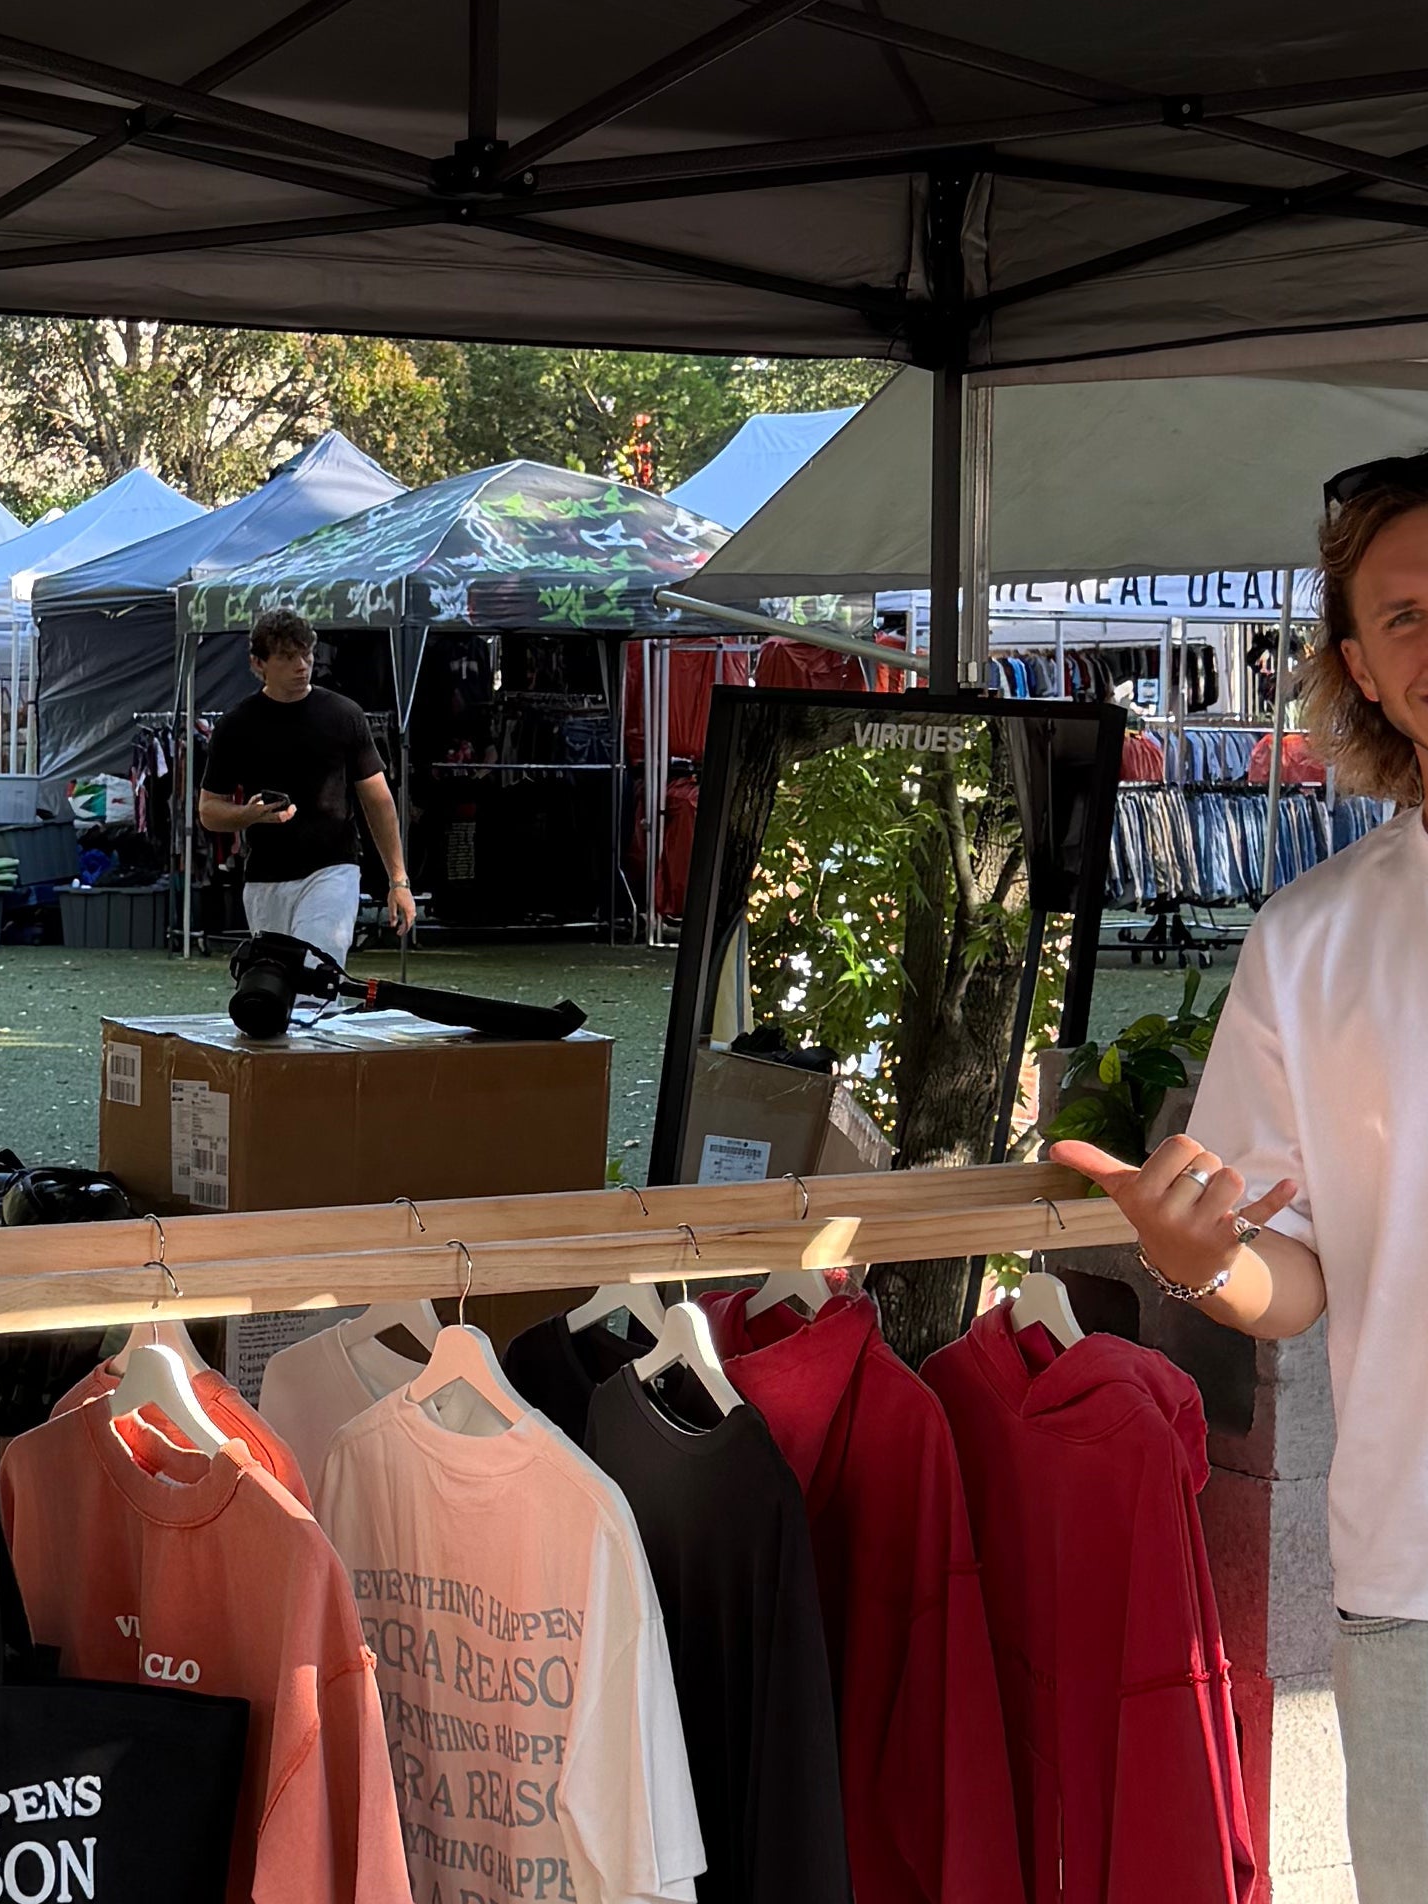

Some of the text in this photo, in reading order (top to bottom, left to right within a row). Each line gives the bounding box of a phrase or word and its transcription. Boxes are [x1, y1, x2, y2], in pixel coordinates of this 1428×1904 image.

[144, 1652, 201, 1684] CLO
[422, 1628, 445, 1684] A
[454, 1635, 578, 1709] REASO
[429, 1772, 456, 1819] A
